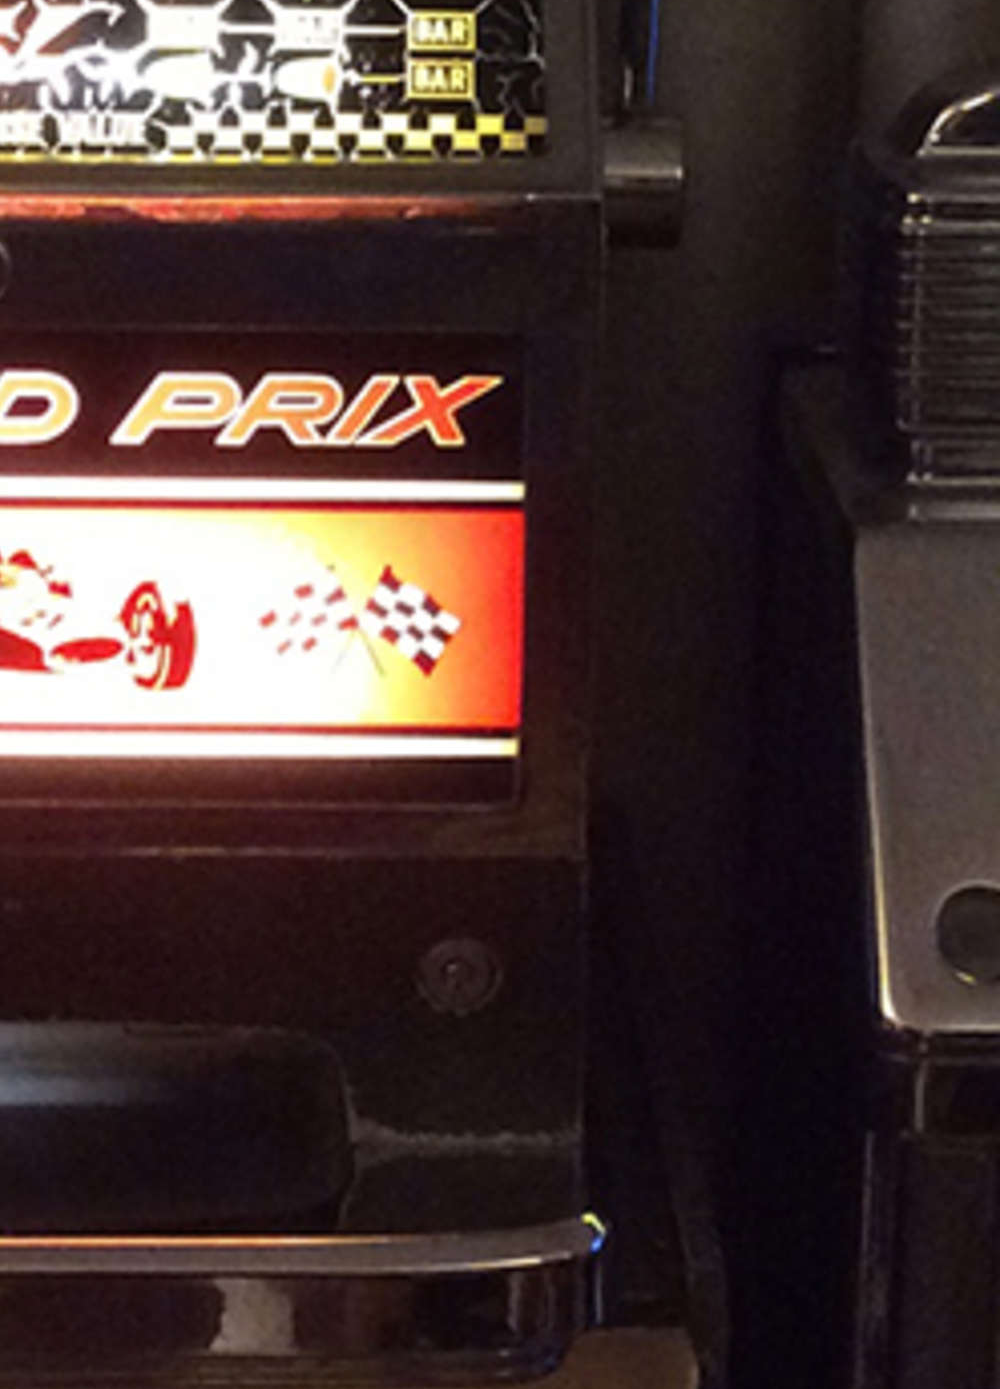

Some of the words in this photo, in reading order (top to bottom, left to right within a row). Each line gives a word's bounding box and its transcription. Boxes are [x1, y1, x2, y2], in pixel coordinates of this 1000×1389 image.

[413, 17, 467, 42] BAR
[414, 66, 467, 91] BAR
[109, 371, 502, 446] PRIX
